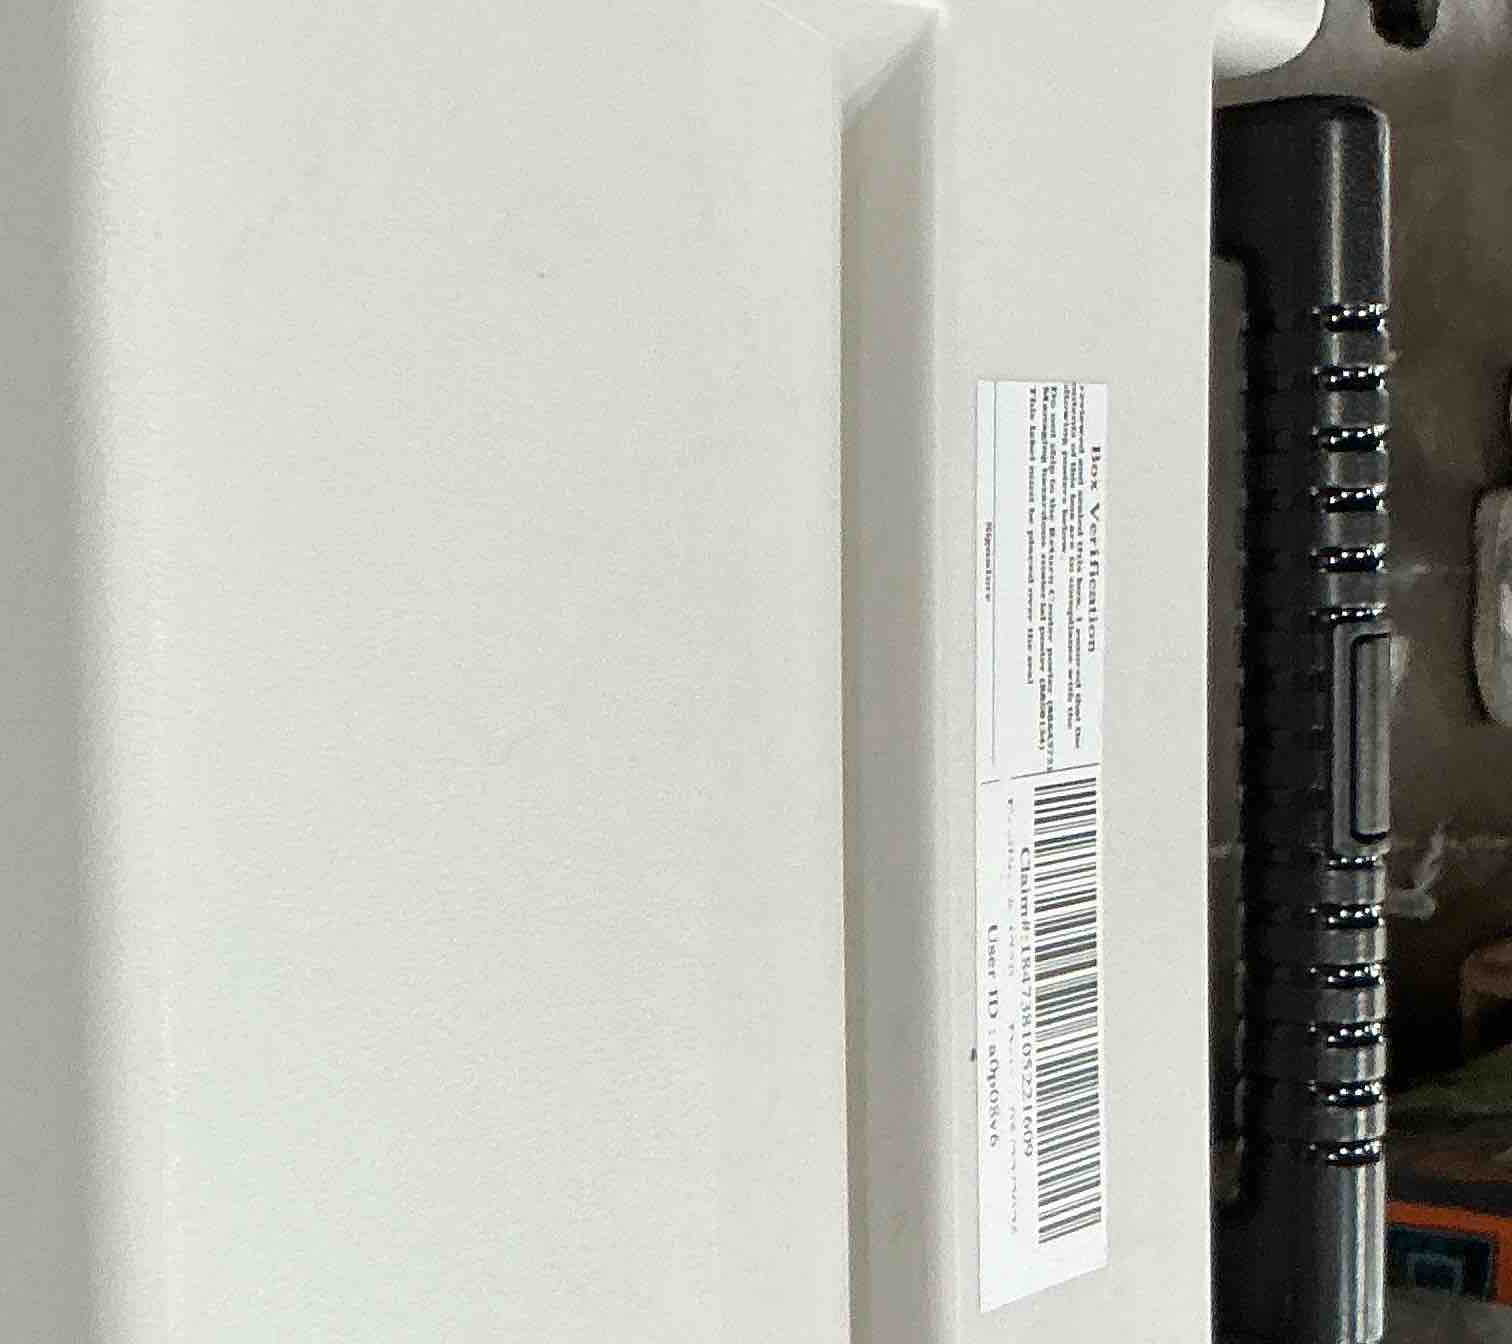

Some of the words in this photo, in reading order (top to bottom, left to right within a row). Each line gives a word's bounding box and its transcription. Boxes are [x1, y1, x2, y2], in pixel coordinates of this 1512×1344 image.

[1040, 387, 1048, 463] Managing
[1090, 446, 1101, 491] Box
[1088, 502, 1100, 653] Verification
[987, 924, 998, 980] User
[987, 990, 998, 1017] ID
